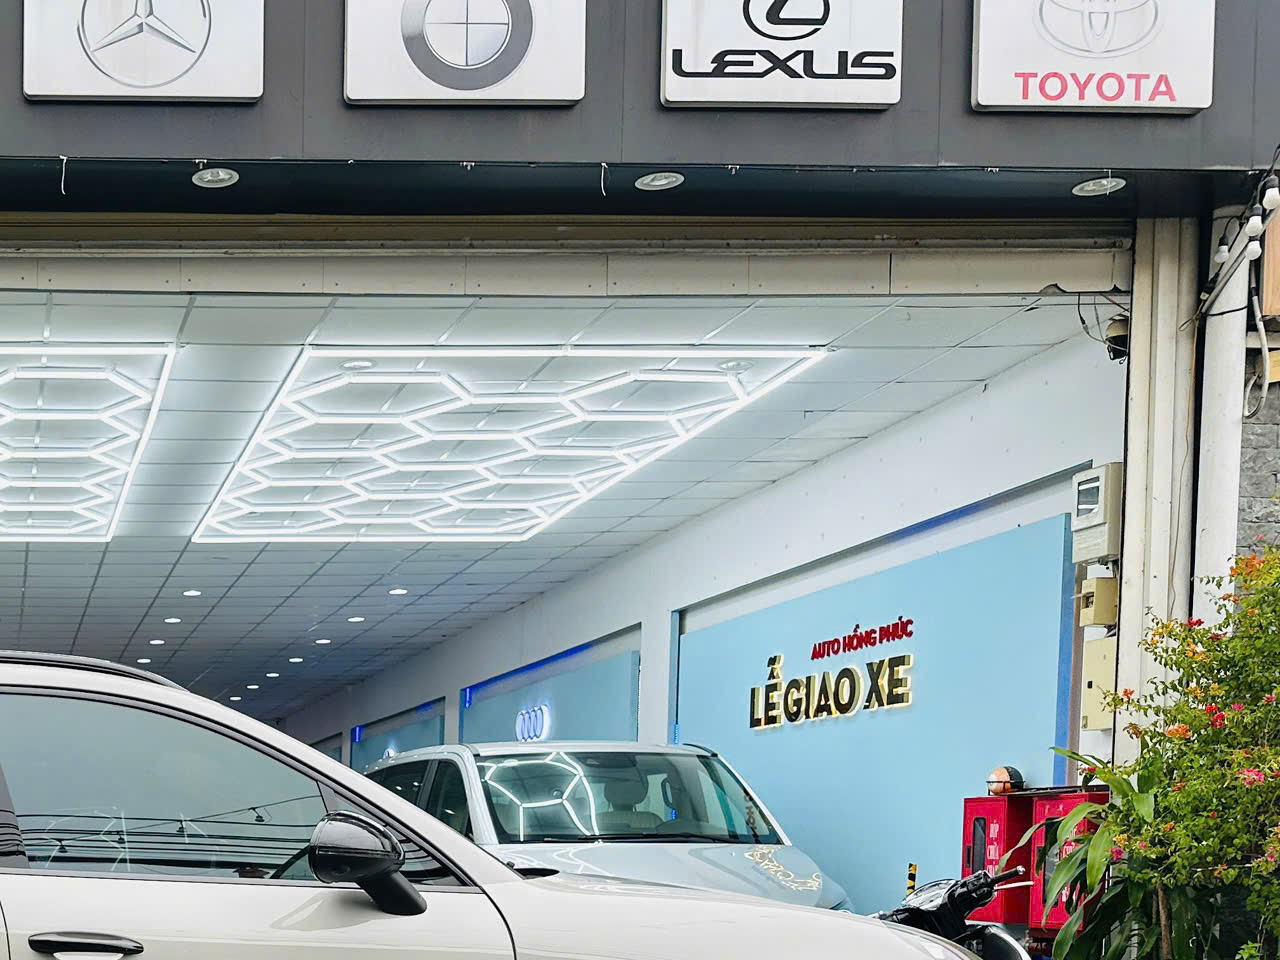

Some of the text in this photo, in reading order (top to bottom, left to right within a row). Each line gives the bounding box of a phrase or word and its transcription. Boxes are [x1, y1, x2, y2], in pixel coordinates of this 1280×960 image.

[671, 48, 897, 80] LEXUS
[1014, 72, 1177, 102] TOYOTA
[811, 638, 840, 660] AUTO
[879, 616, 913, 645] PHÚC
[784, 667, 863, 722] GIAO
[863, 655, 912, 709] XE
